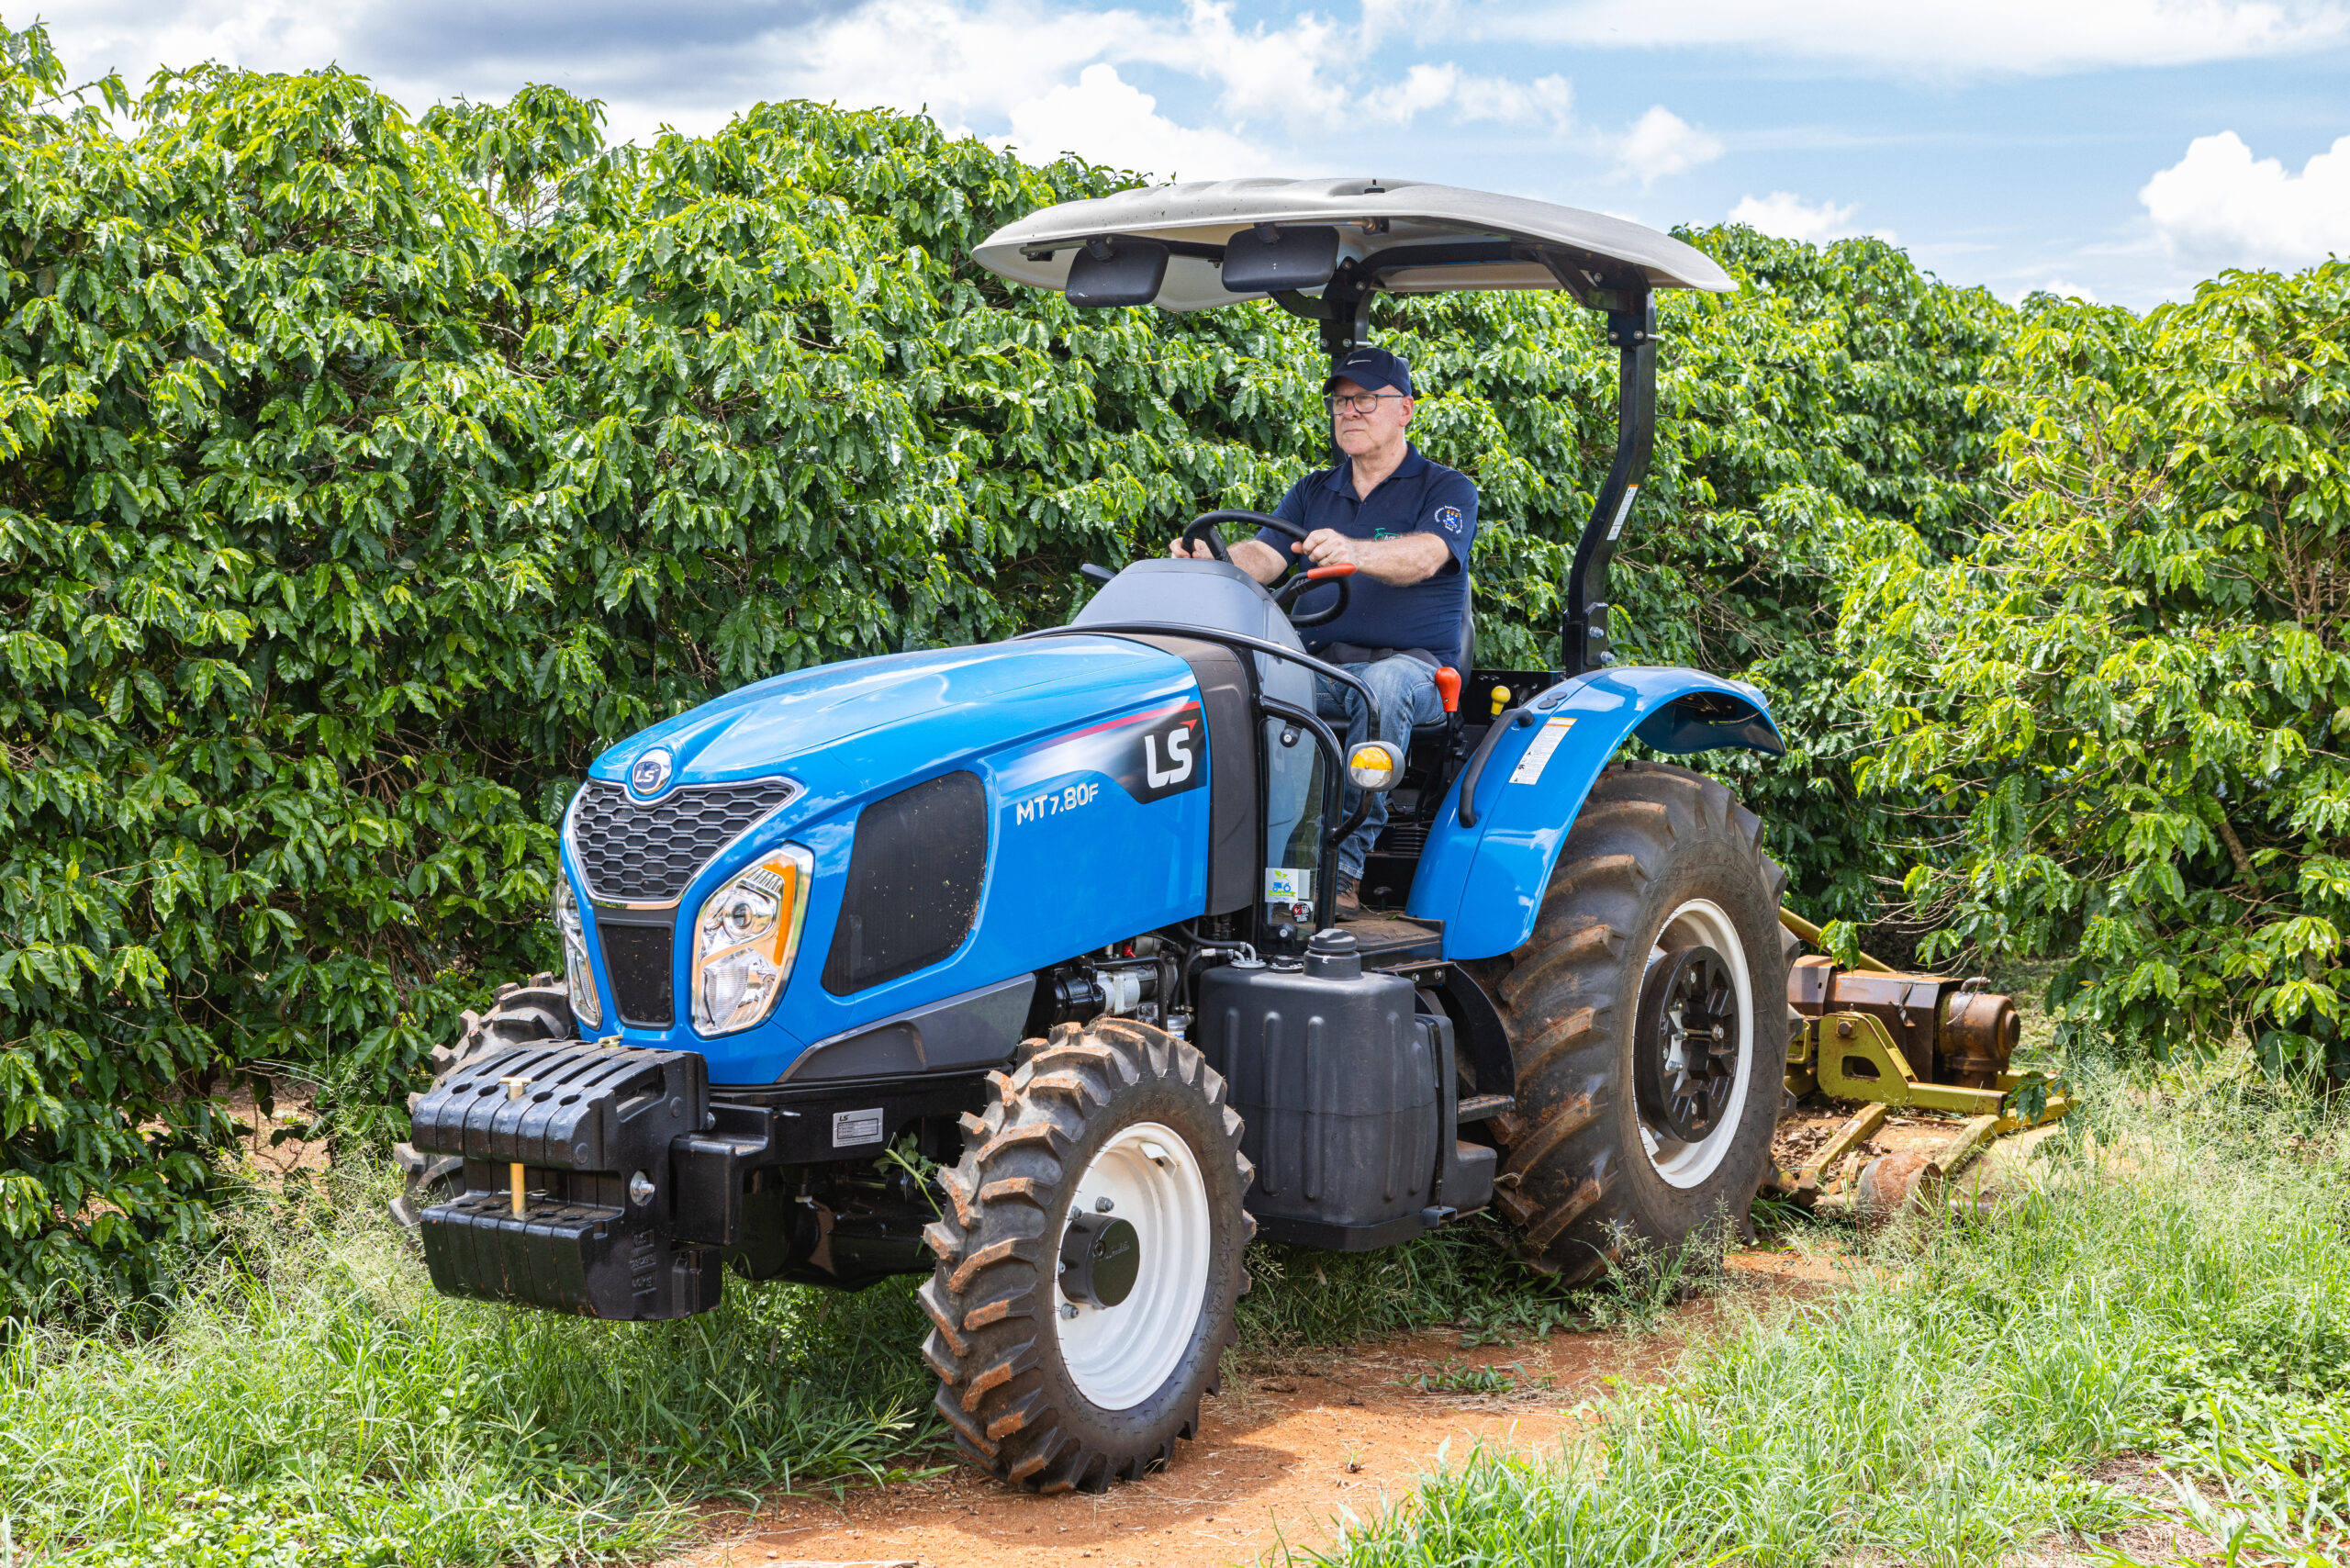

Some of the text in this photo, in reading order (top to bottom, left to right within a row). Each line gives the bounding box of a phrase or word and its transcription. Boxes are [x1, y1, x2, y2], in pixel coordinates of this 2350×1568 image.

[635, 769, 655, 783] LS
[1145, 727, 1192, 789] LS
[1015, 782, 1100, 825] MT7.80F
